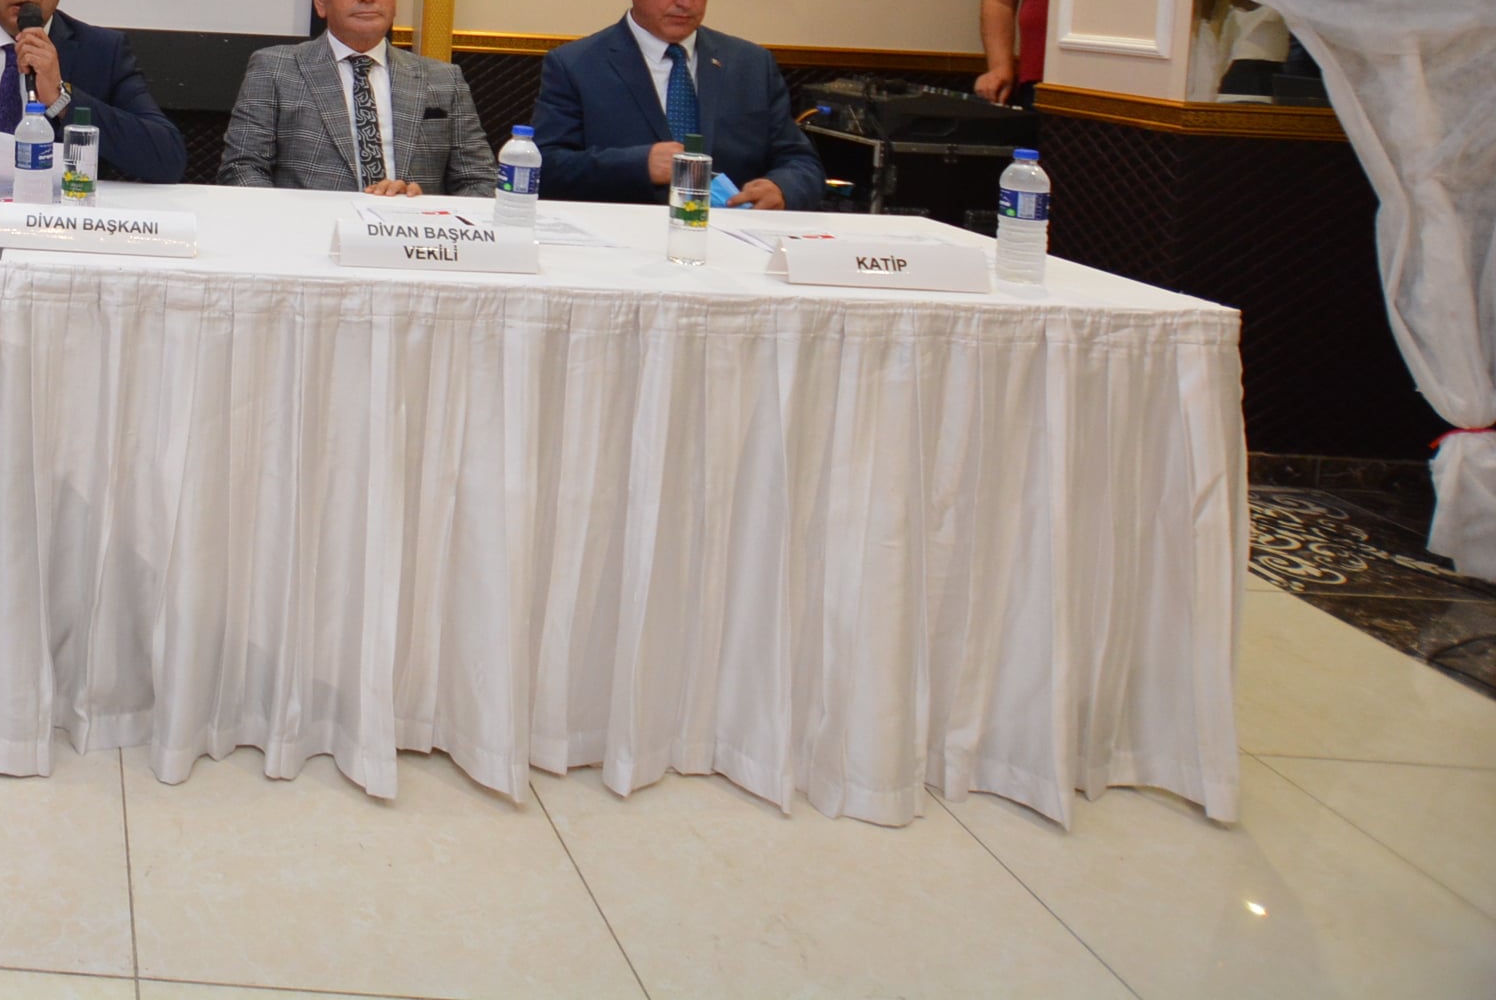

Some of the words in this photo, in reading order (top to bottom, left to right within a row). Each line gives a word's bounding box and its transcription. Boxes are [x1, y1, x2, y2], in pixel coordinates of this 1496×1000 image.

[26, 212, 77, 230] DİVAN
[83, 218, 159, 235] BAŞKANI
[367, 222, 419, 238] DİVAN
[424, 226, 496, 243] BAŞKAN
[404, 244, 458, 261] VEKİLİ
[855, 255, 908, 272] KATİP
